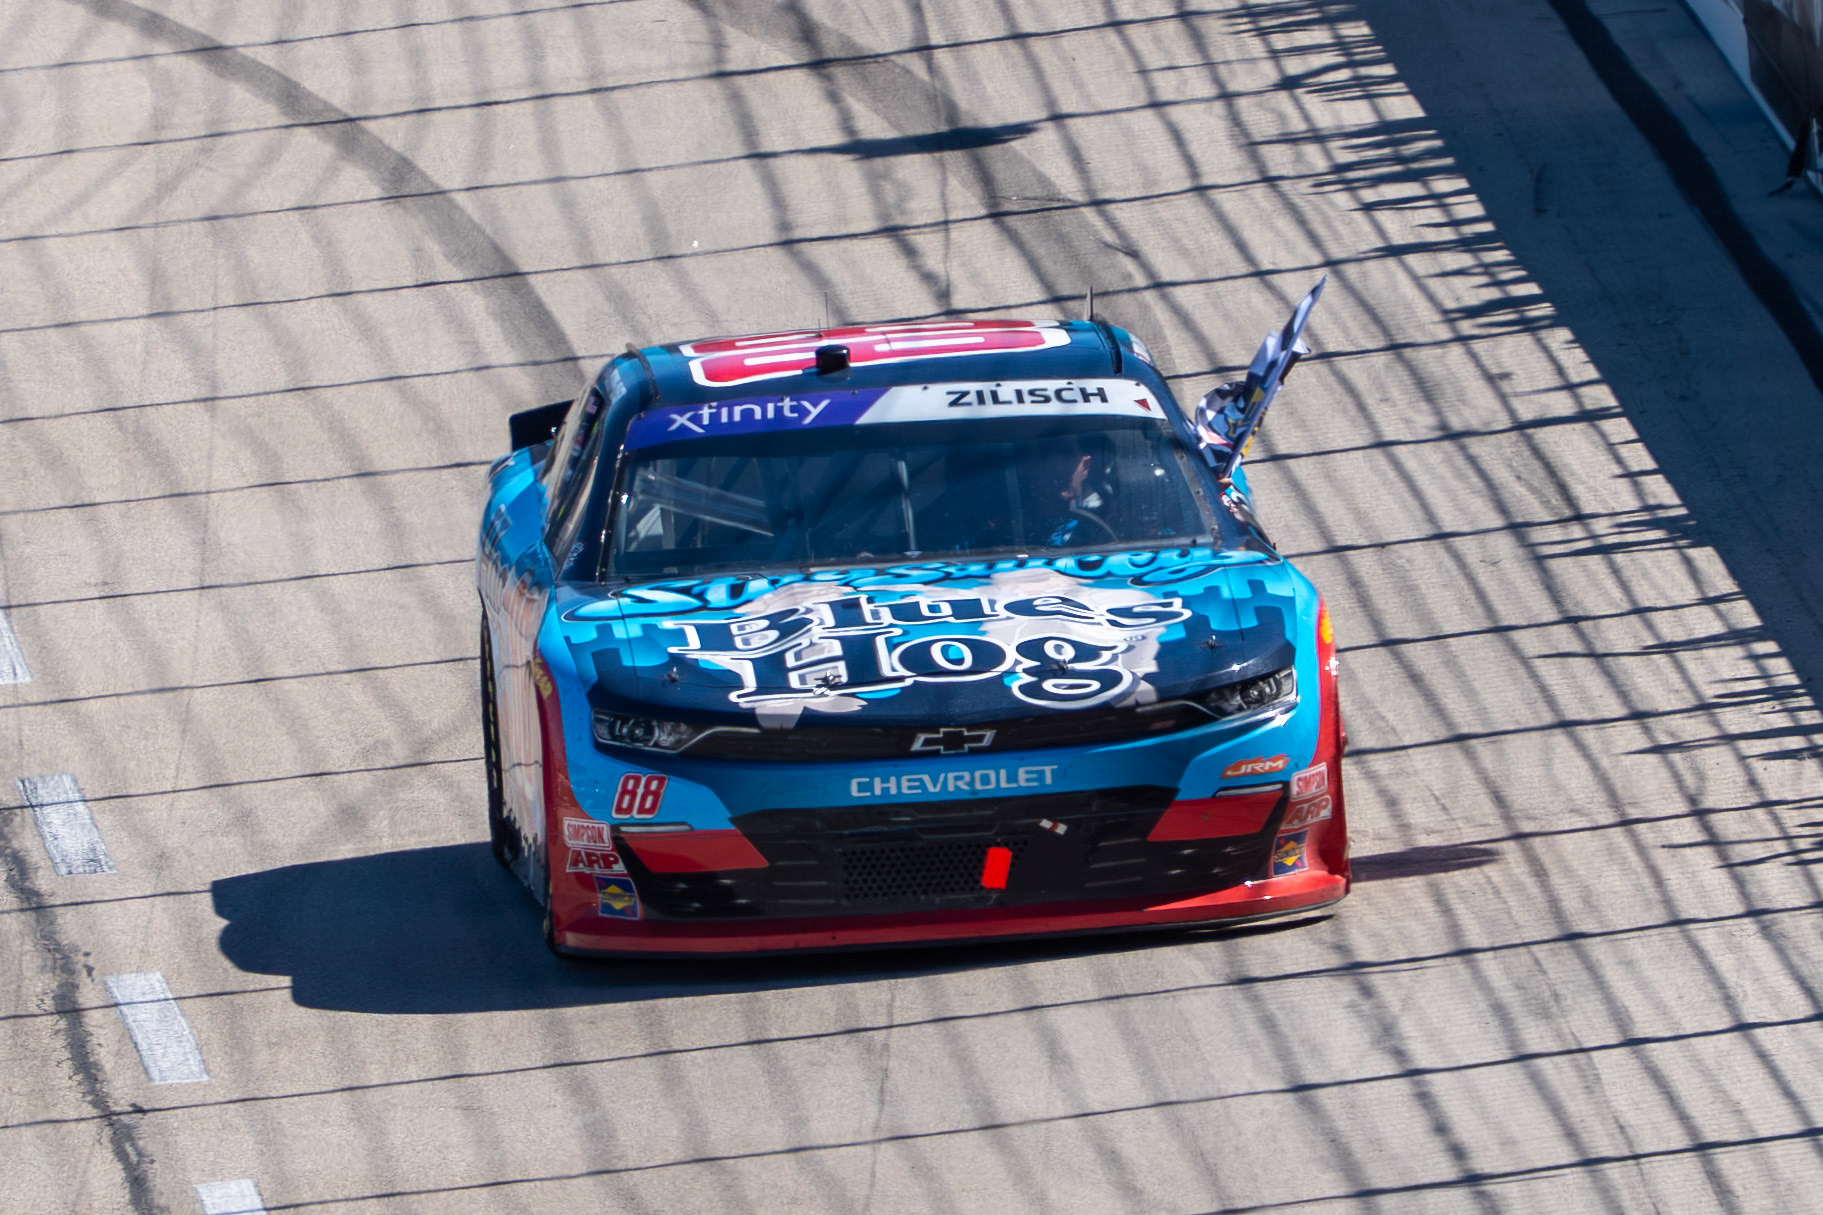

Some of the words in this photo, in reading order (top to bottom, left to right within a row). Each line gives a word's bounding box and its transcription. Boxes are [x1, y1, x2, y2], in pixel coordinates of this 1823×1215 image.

[946, 386, 1109, 408] ZILISCH
[667, 397, 831, 433] xfinity
[661, 593, 1193, 658] Blues
[729, 628, 1133, 710] Hog
[851, 765, 1058, 797] CHEVROLET
[1226, 760, 1283, 775] JRM
[611, 773, 668, 819] 88
[567, 822, 605, 845] SIMPSON
[571, 850, 620, 870] ARP
